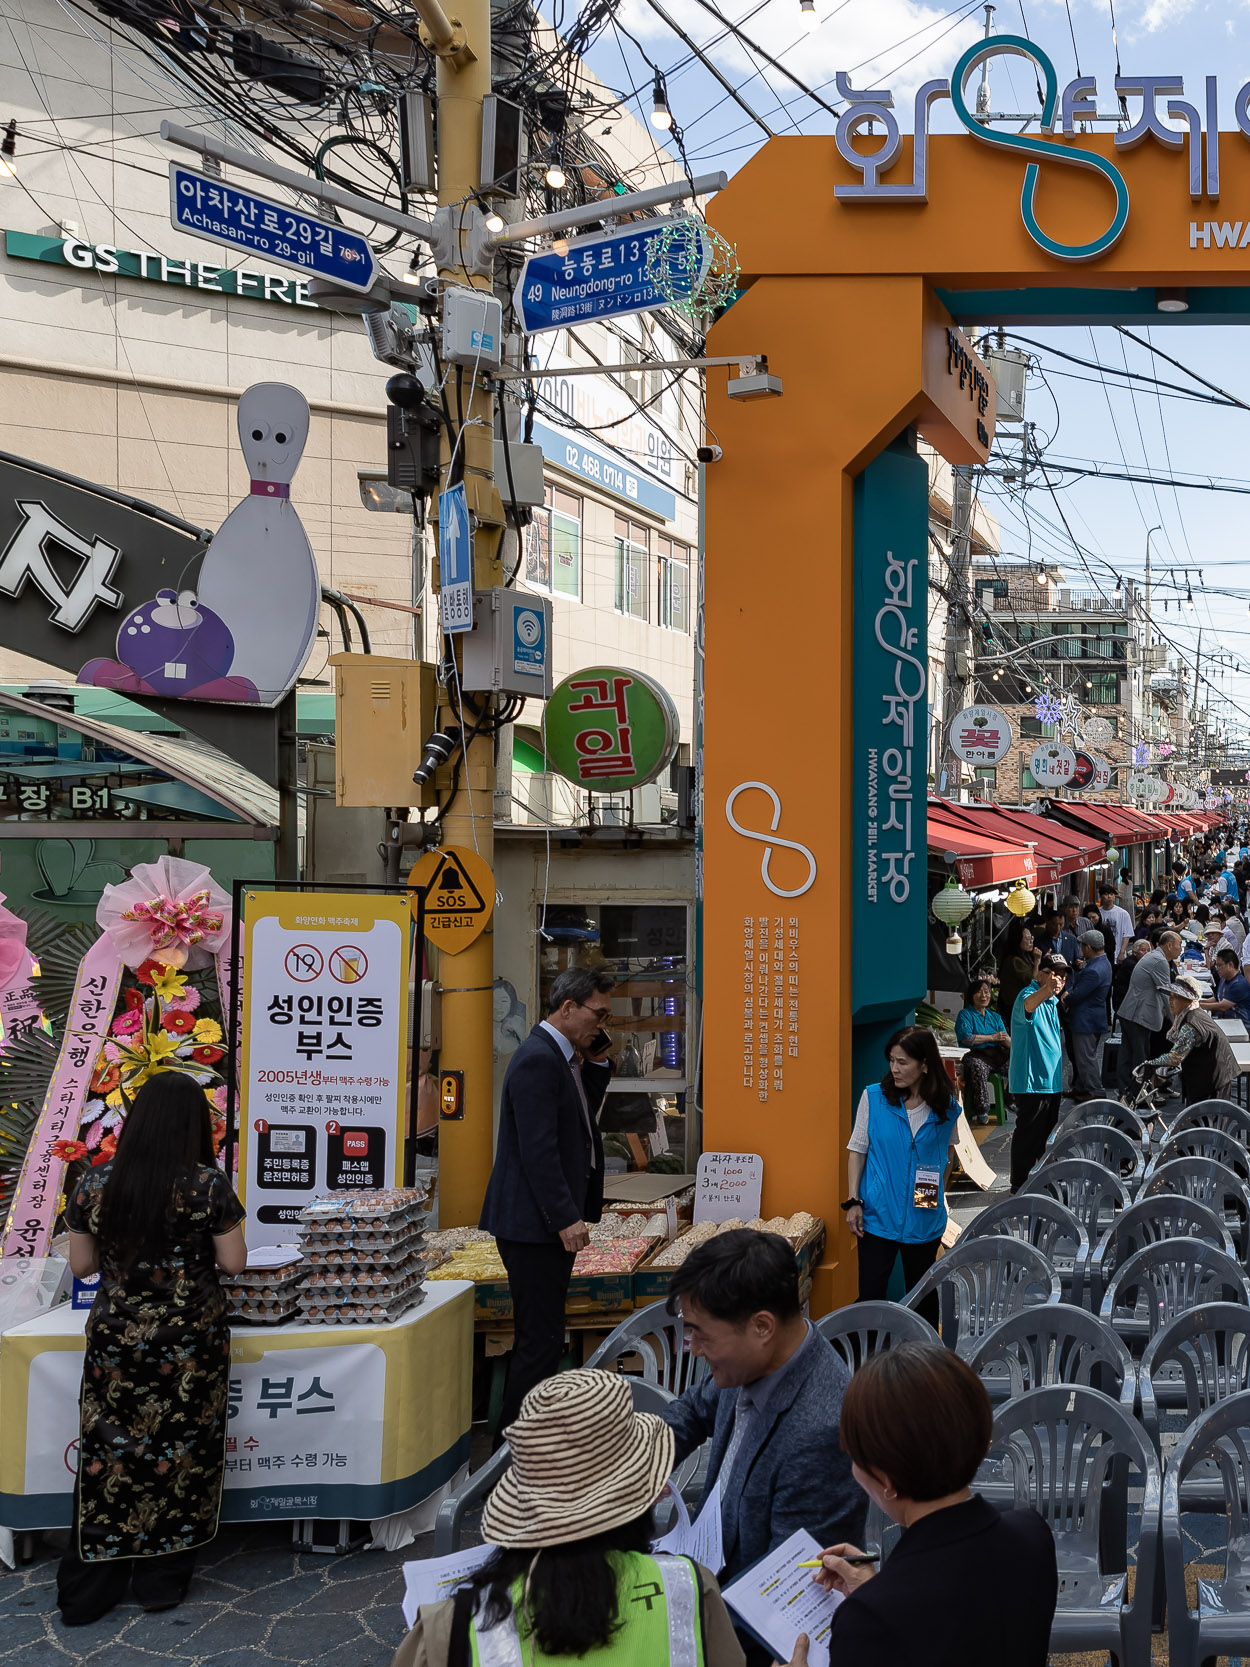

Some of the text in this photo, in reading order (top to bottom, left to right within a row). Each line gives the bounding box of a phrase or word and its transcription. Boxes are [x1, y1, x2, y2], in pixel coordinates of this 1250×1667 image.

[179, 179, 334, 257] 아차산로29길
[181, 208, 315, 266] Achasan-ro 29-gil
[62, 237, 322, 308] GS THE FRE
[527, 283, 543, 302] 49
[551, 272, 633, 301] Neungdong-ro
[603, 465, 624, 490] 0714
[567, 677, 637, 780] 과일
[873, 550, 926, 904] 화양제일시장
[959, 728, 1001, 749] 꽃
[71, 786, 113, 810] B1
[867, 749, 878, 902] HWAYANG JEIL MARKET
[436, 895, 466, 907] SOS
[430, 916, 474, 929] 긴급신고
[758, 917, 769, 950] 발전을
[773, 917, 784, 972] 기성세대와
[788, 917, 799, 1058] 뫼비우스의 띠는 전통과 현대
[267, 994, 384, 1028] 성인인증
[743, 917, 754, 1088] 화양제일시장의 심볼과 로고입니다
[67, 974, 108, 1069] 신한은행
[295, 1031, 353, 1061] 부스
[758, 1021, 769, 1054] 컨셉을
[773, 1033, 784, 1066] 조화를
[339, 1076, 355, 1085] 맥주
[356, 1076, 372, 1087] 수령
[374, 1077, 390, 1087] 가능
[758, 1057, 769, 1102] 형상화한
[773, 1069, 784, 1091] 이뤄
[264, 1093, 296, 1103] 성인인증
[298, 1093, 314, 1103] 확인
[315, 1094, 324, 1104] 후
[325, 1094, 342, 1103] 팔찌
[280, 1106, 365, 1116] 맥주 교환이 가능합니다.
[258, 1120, 264, 1131] 1
[329, 1122, 336, 1133] 2
[346, 1140, 366, 1148] PASS
[263, 1158, 309, 1170] 주민등록증
[342, 1160, 369, 1172] 패스앱
[710, 1154, 732, 1164] 과자
[263, 1171, 309, 1183] 운전면허증
[337, 1173, 374, 1184] 성인인증
[917, 1187, 937, 1197] STAFF
[256, 1376, 336, 1420] 부스
[257, 1455, 286, 1470] 맥주
[290, 1452, 318, 1468] 수령
[322, 1452, 348, 1468] 가능
